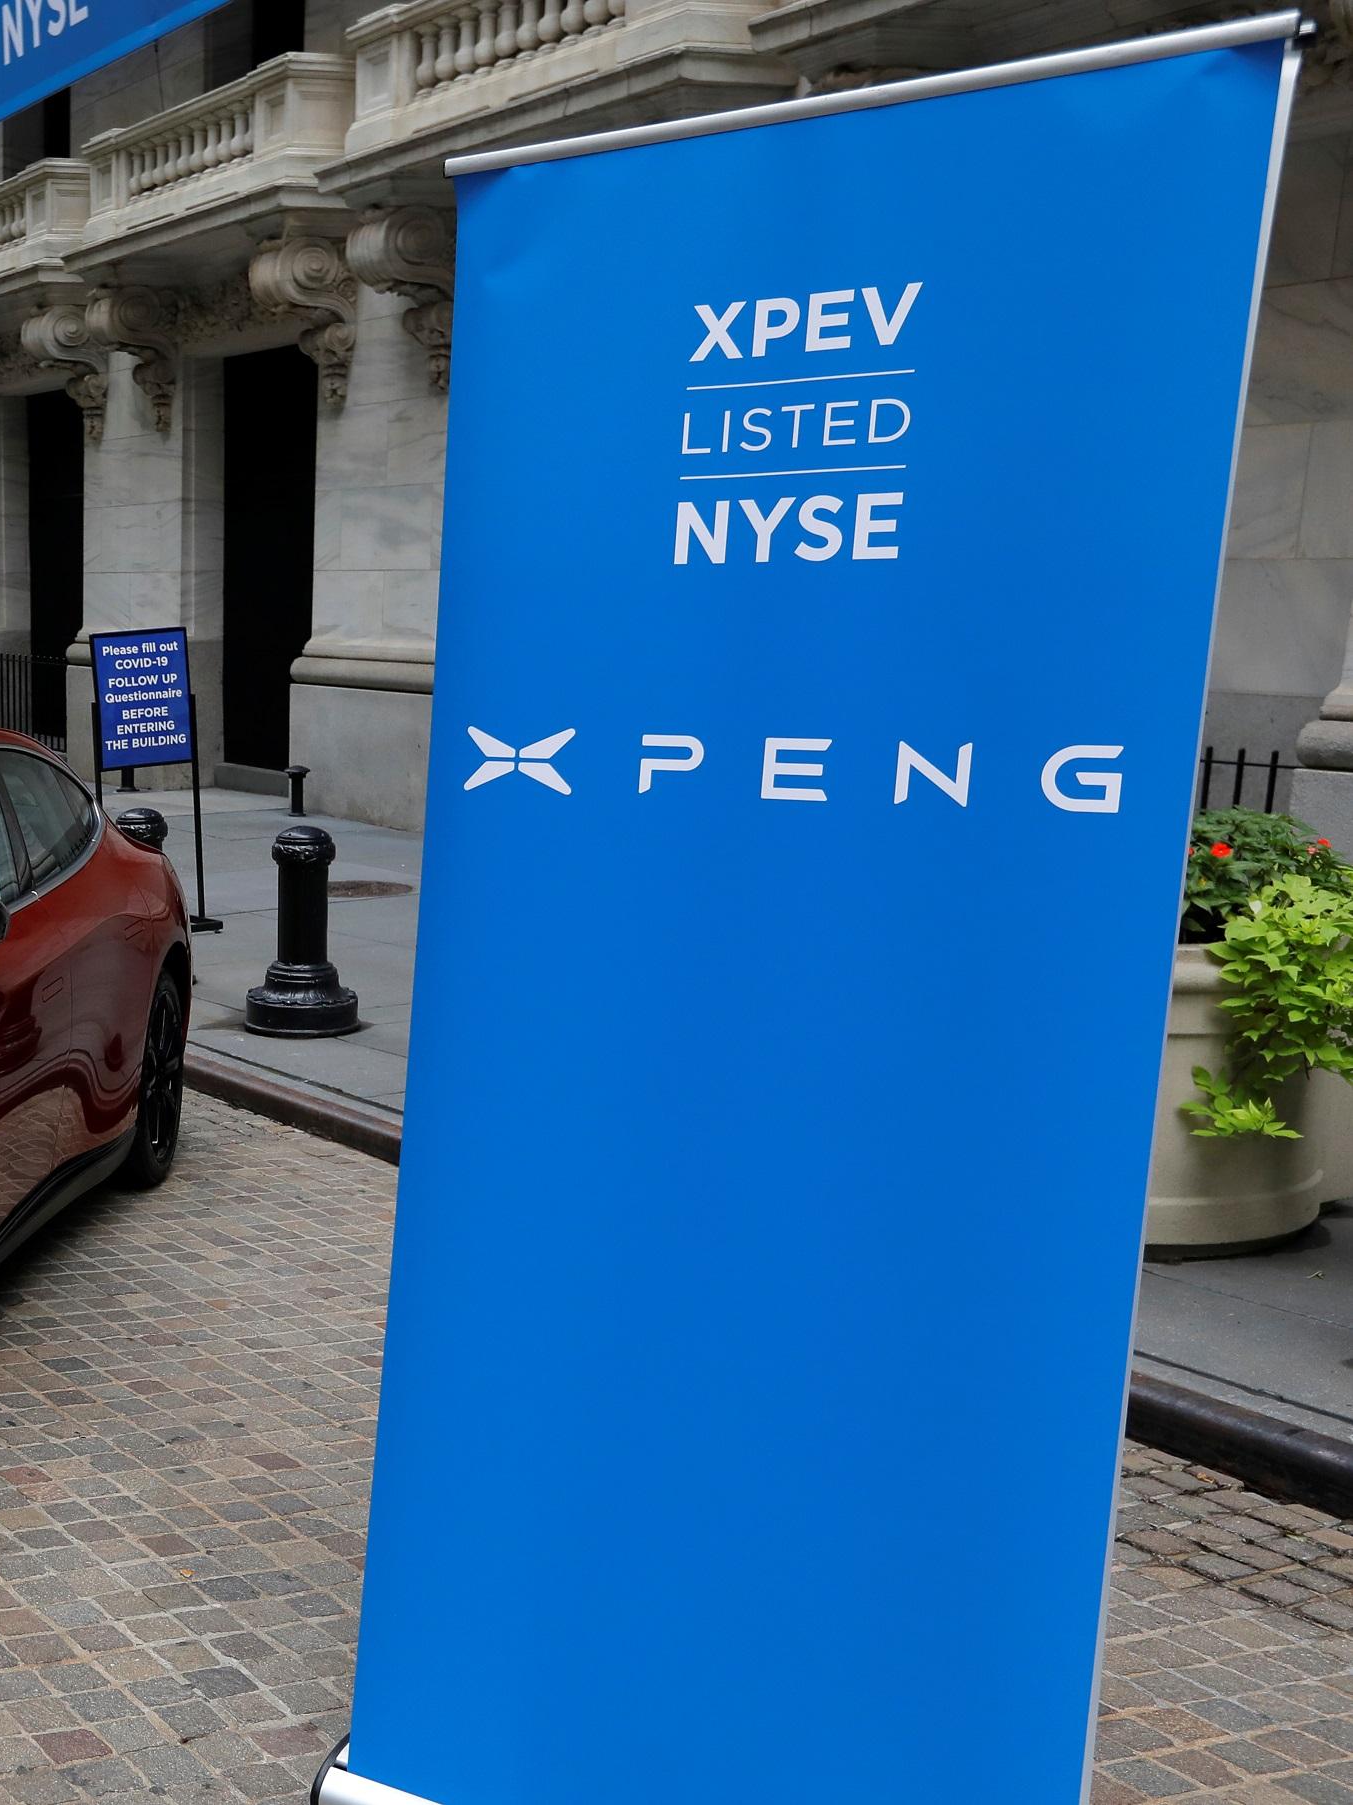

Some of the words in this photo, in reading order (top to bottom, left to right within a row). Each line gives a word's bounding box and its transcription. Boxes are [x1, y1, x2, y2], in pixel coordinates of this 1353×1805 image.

[689, 281, 924, 363] XPEV
[680, 397, 912, 455] LISTED
[673, 491, 905, 566] NYSE
[102, 646, 139, 656] Please
[142, 643, 156, 653] fill
[159, 641, 178, 652] out
[114, 656, 168, 670] COVID-19
[108, 675, 158, 688] FOLLOW
[162, 673, 178, 684] UP
[105, 688, 183, 704] Questionnaire
[122, 706, 169, 720] BEFORE
[117, 720, 175, 735] ENTERING
[105, 739, 129, 750] THE
[132, 734, 187, 748] BUILDING
